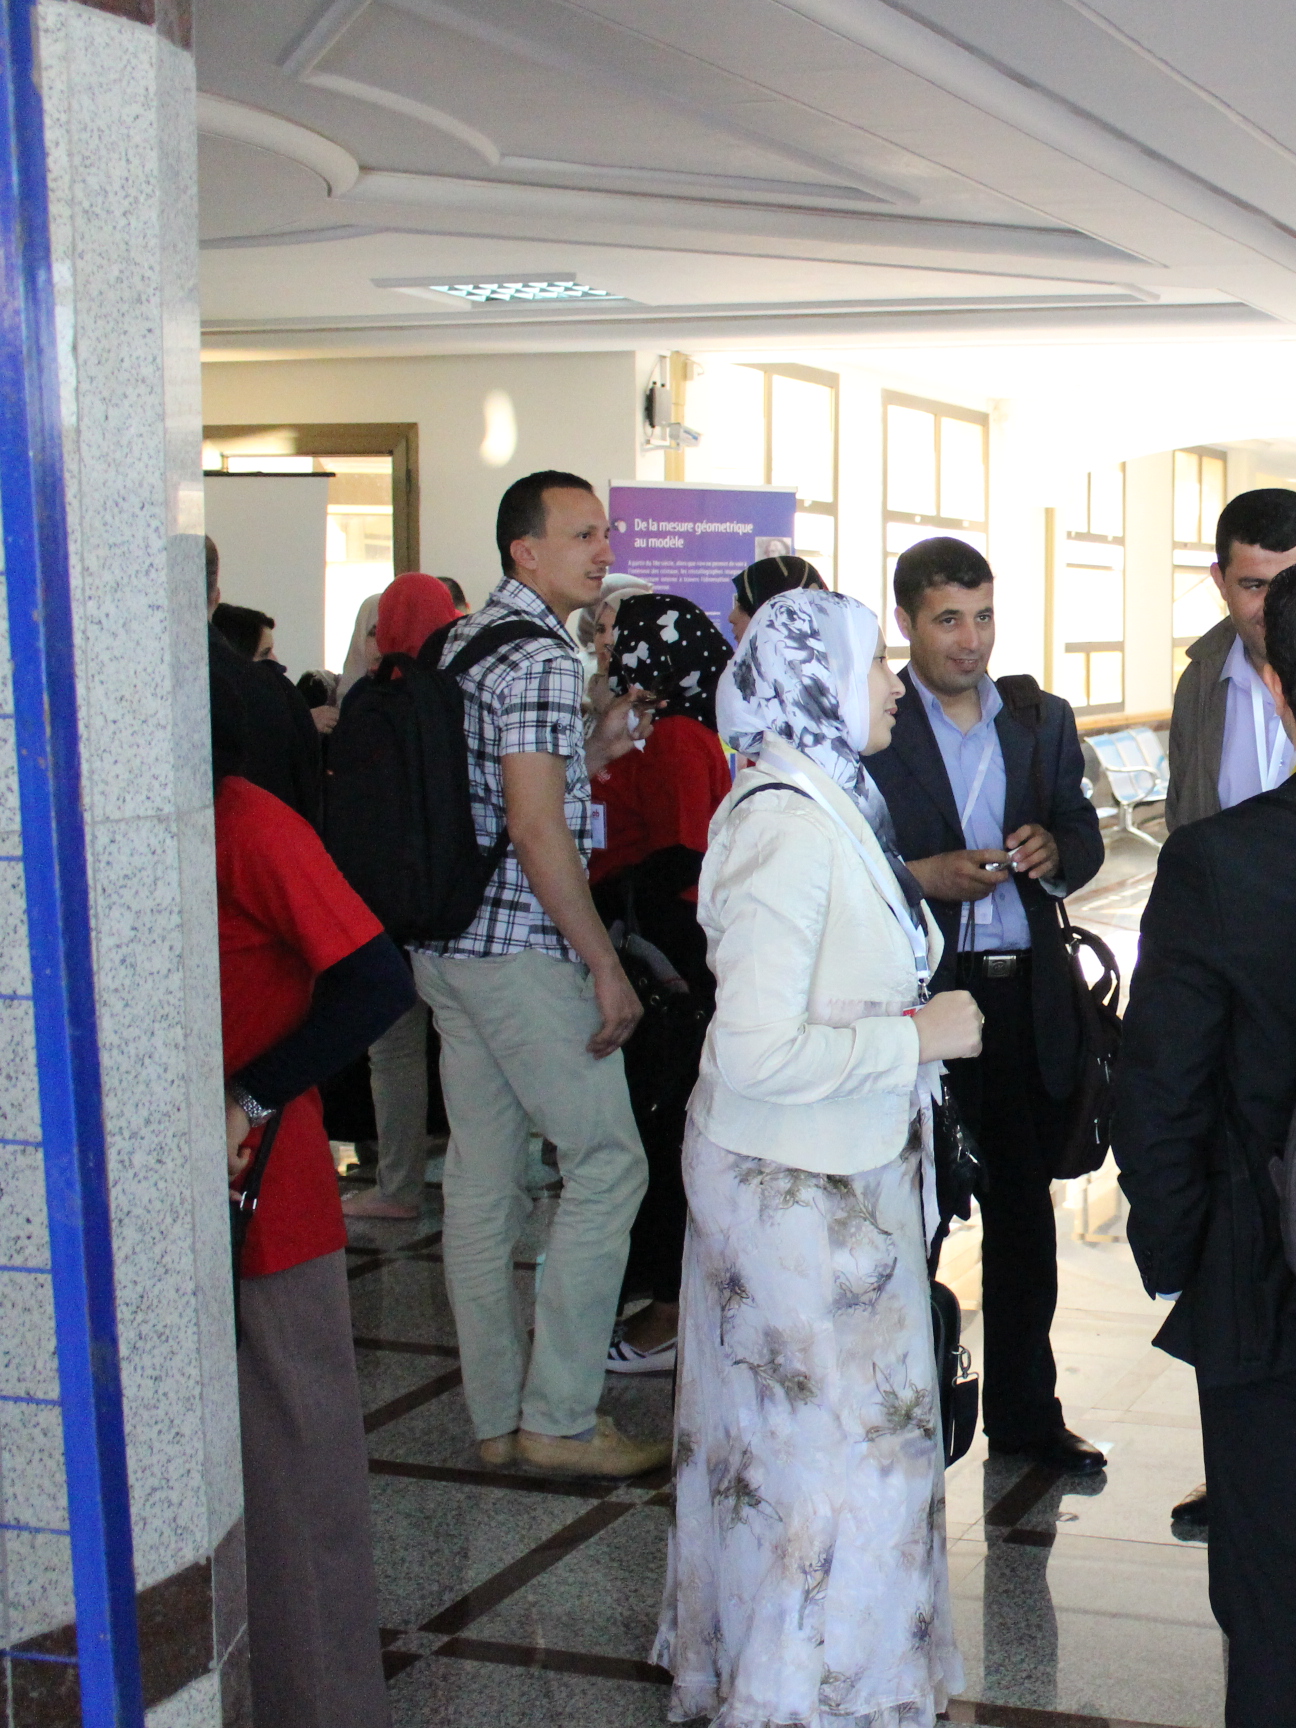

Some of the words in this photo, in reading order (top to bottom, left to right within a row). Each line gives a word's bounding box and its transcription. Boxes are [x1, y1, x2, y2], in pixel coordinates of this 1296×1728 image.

[634, 518, 647, 532] De
[649, 518, 658, 532] la
[659, 521, 693, 533] mesure
[695, 519, 753, 536] géometrique
[634, 539, 647, 549] au
[648, 536, 684, 549] modèle
